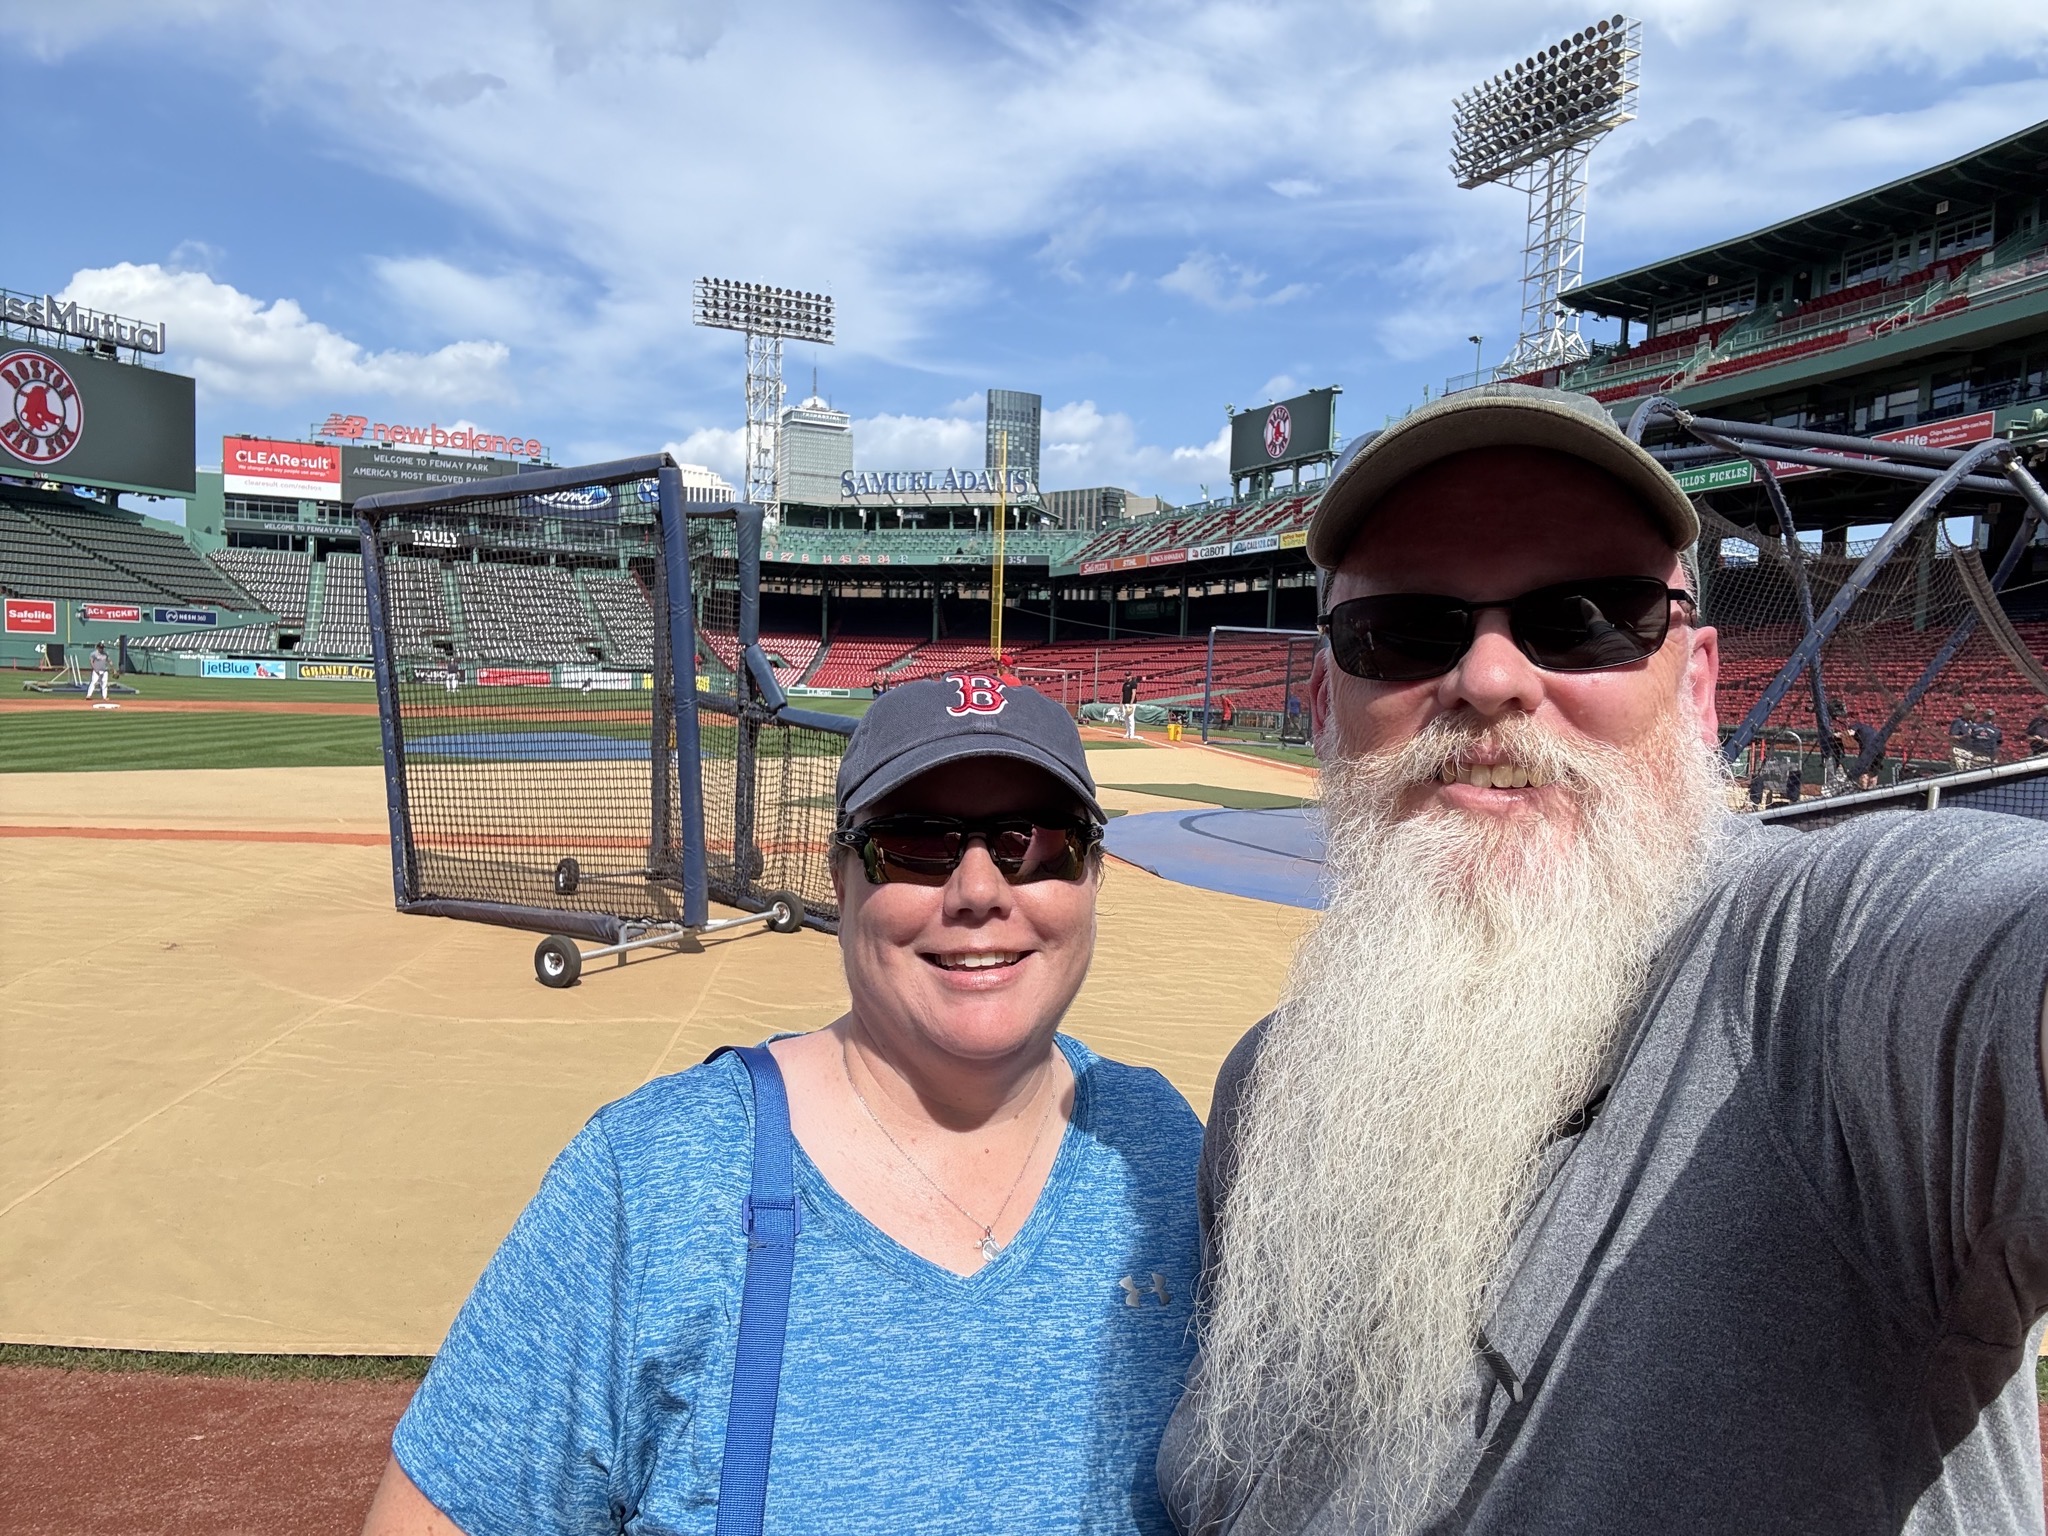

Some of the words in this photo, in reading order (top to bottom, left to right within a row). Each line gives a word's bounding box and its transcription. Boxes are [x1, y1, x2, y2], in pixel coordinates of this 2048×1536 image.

[0, 294, 165, 353] ssMutual
[1, 360, 76, 400] BOSTON
[1, 419, 39, 455] RED
[46, 425, 76, 456] SOX
[236, 450, 329, 469] CLEAResult
[374, 454, 413, 465] WELCOME
[416, 458, 426, 466] TO
[429, 460, 464, 470] FENWAY
[466, 463, 489, 472] PARK
[353, 467, 398, 478] AMERICA'S
[401, 471, 424, 480] MOST
[426, 473, 463, 484] BELOVED
[1709, 466, 1748, 483] PICKLES
[841, 470, 938, 497] SAMUEL
[264, 523, 294, 531] WELCOME
[412, 530, 460, 543] TRULY
[1008, 555, 1027, 564] 3:54
[9, 609, 52, 620] Safelite
[106, 609, 138, 619] TICKET
[207, 661, 250, 675] jetBlue
[300, 665, 349, 677] GRANITE
[351, 665, 375, 679] CITY
[945, 674, 1009, 717] B
